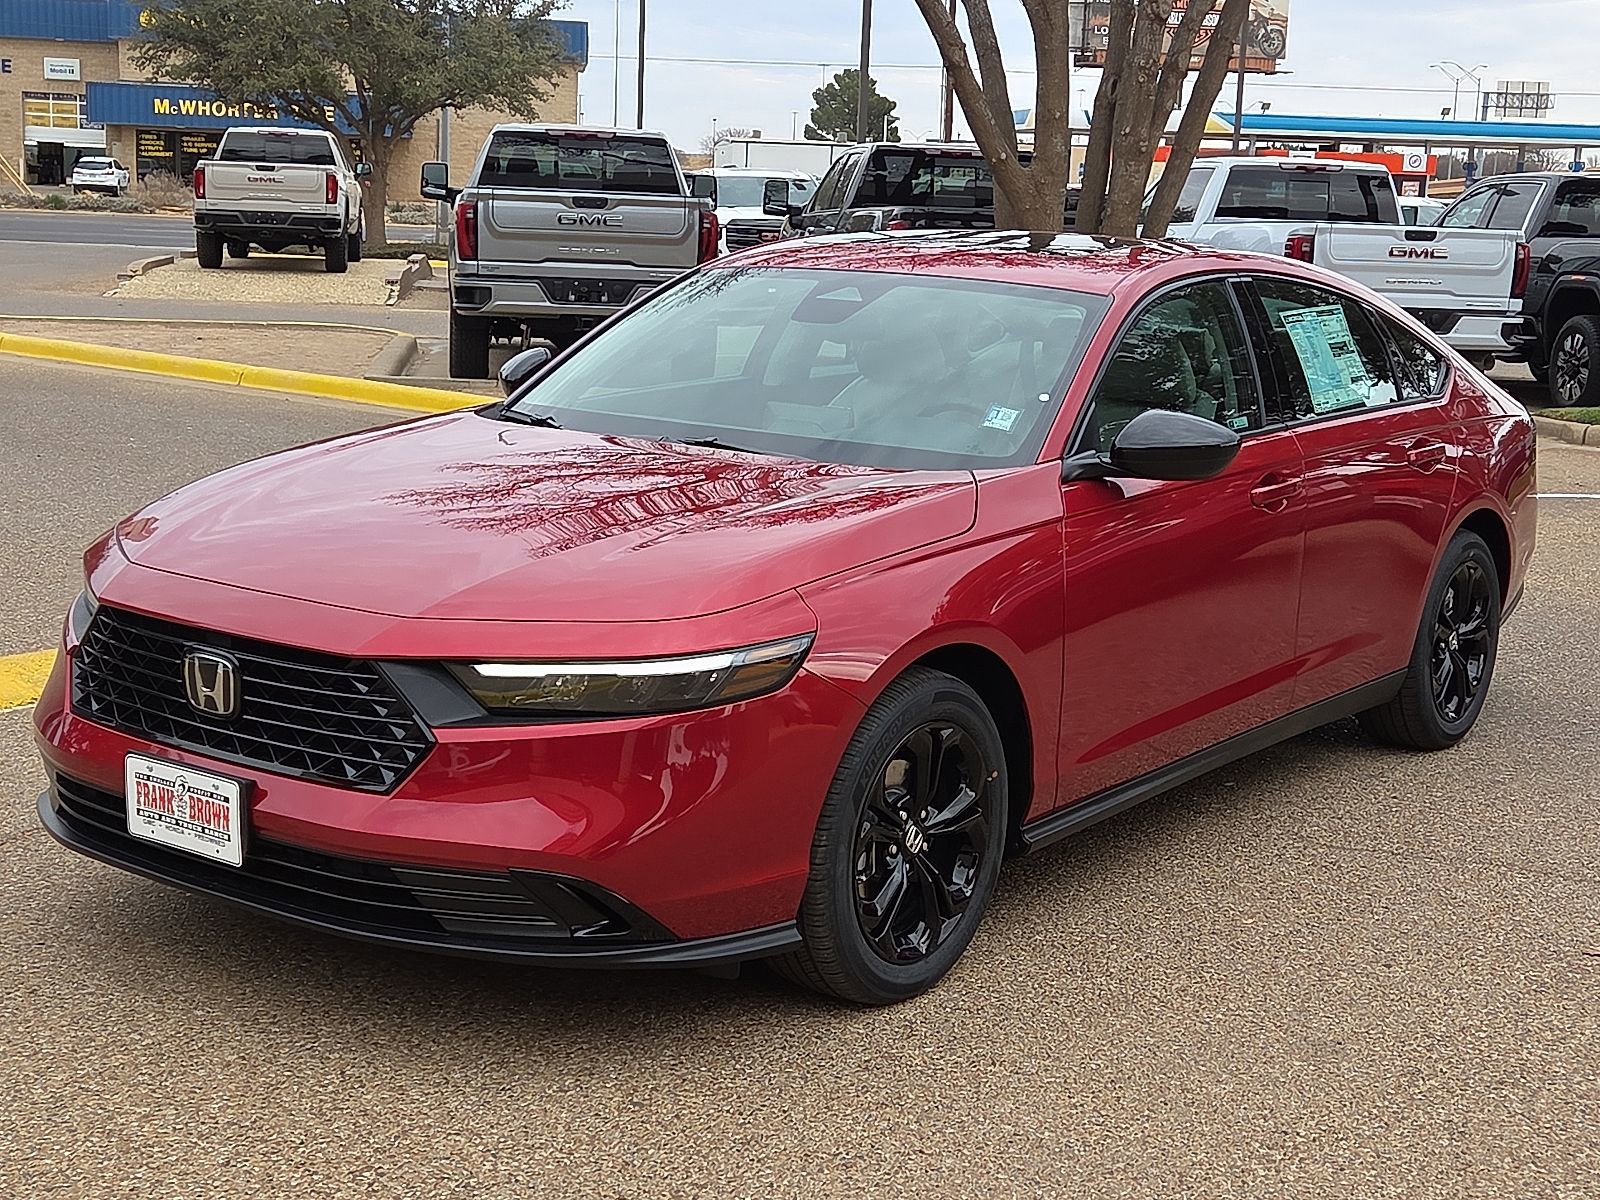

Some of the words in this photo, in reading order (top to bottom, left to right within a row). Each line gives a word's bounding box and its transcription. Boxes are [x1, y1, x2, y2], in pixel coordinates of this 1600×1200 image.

[247, 175, 285, 184] GMC
[556, 212, 624, 228] GMC
[1388, 246, 1449, 260] GMC
[136, 780, 175, 816] FRANK
[189, 795, 231, 832] BROWN
[138, 810, 160, 821] AUTO
[160, 815, 177, 825] AND
[177, 820, 203, 833] TRUCK
[204, 828, 230, 841] RANCH
